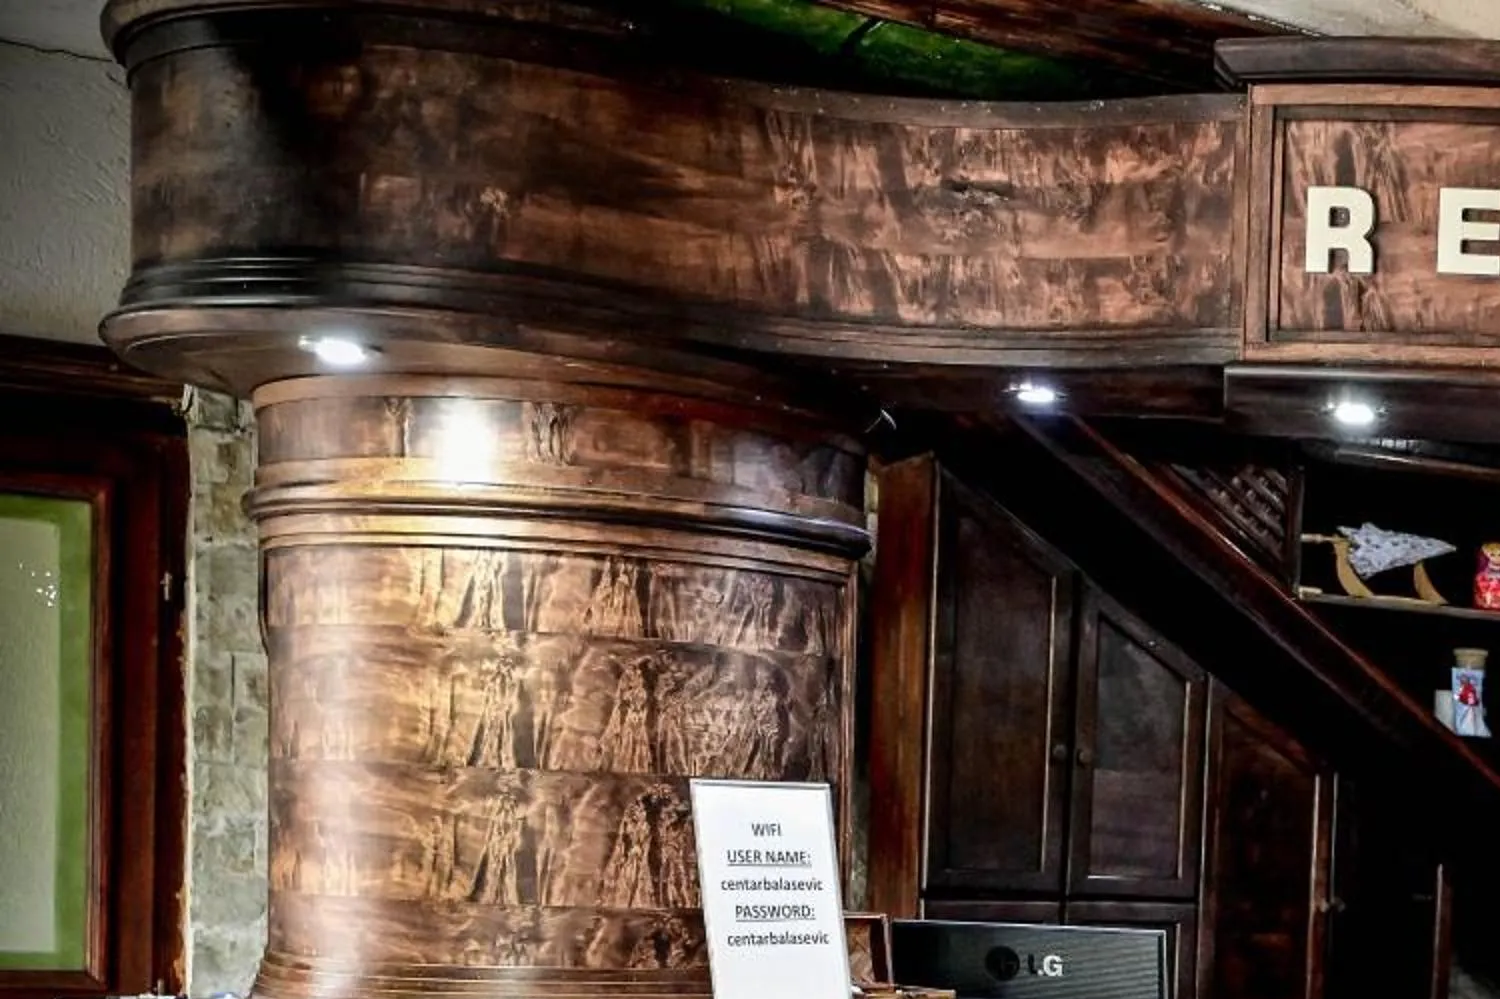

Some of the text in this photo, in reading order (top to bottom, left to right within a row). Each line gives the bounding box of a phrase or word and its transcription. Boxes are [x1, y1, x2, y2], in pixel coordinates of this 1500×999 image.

[751, 823, 782, 837] WIFI
[727, 849, 812, 866] USER NAME:
[720, 876, 824, 891] centarbalasevic
[735, 904, 816, 919] PASSWORD:
[727, 931, 830, 946] centarbalasevic
